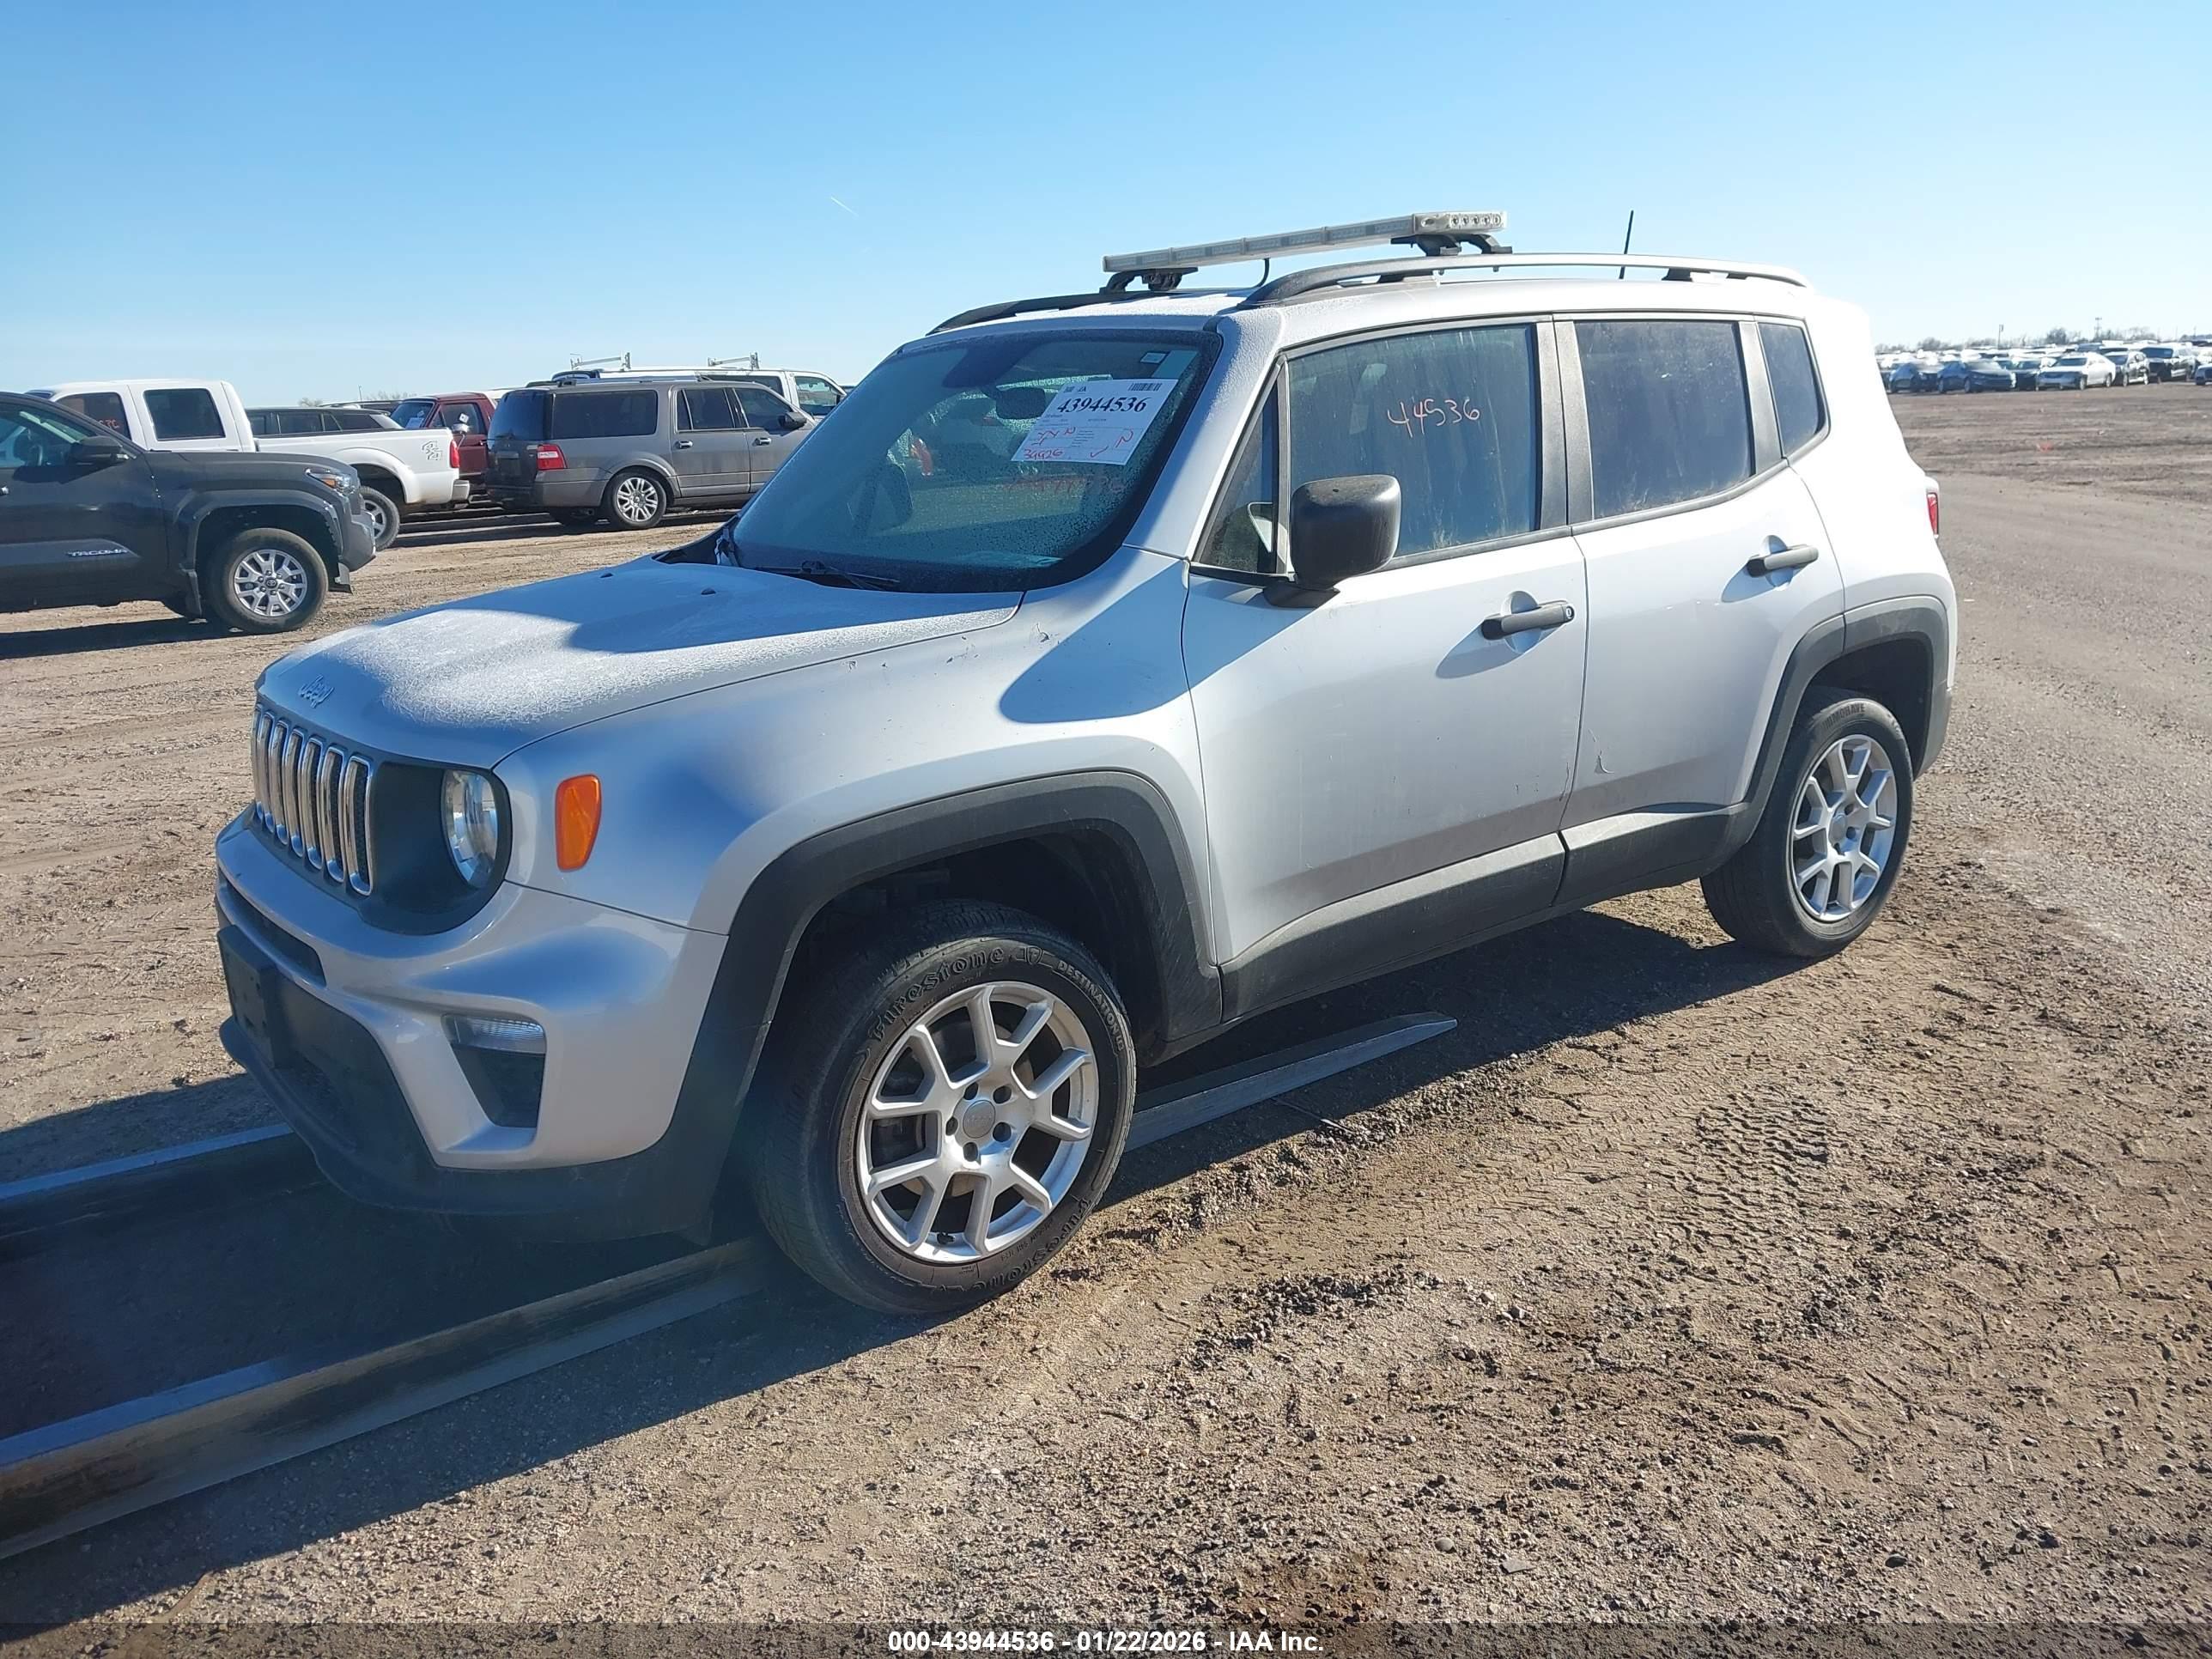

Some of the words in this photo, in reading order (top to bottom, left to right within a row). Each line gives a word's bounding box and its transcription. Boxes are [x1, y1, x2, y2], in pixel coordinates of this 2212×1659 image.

[1057, 397, 1152, 413] 43944536
[1387, 398, 1480, 438] 44536
[66, 548, 128, 557] TACOMA
[1057, 959, 1122, 1036] DESTINATION
